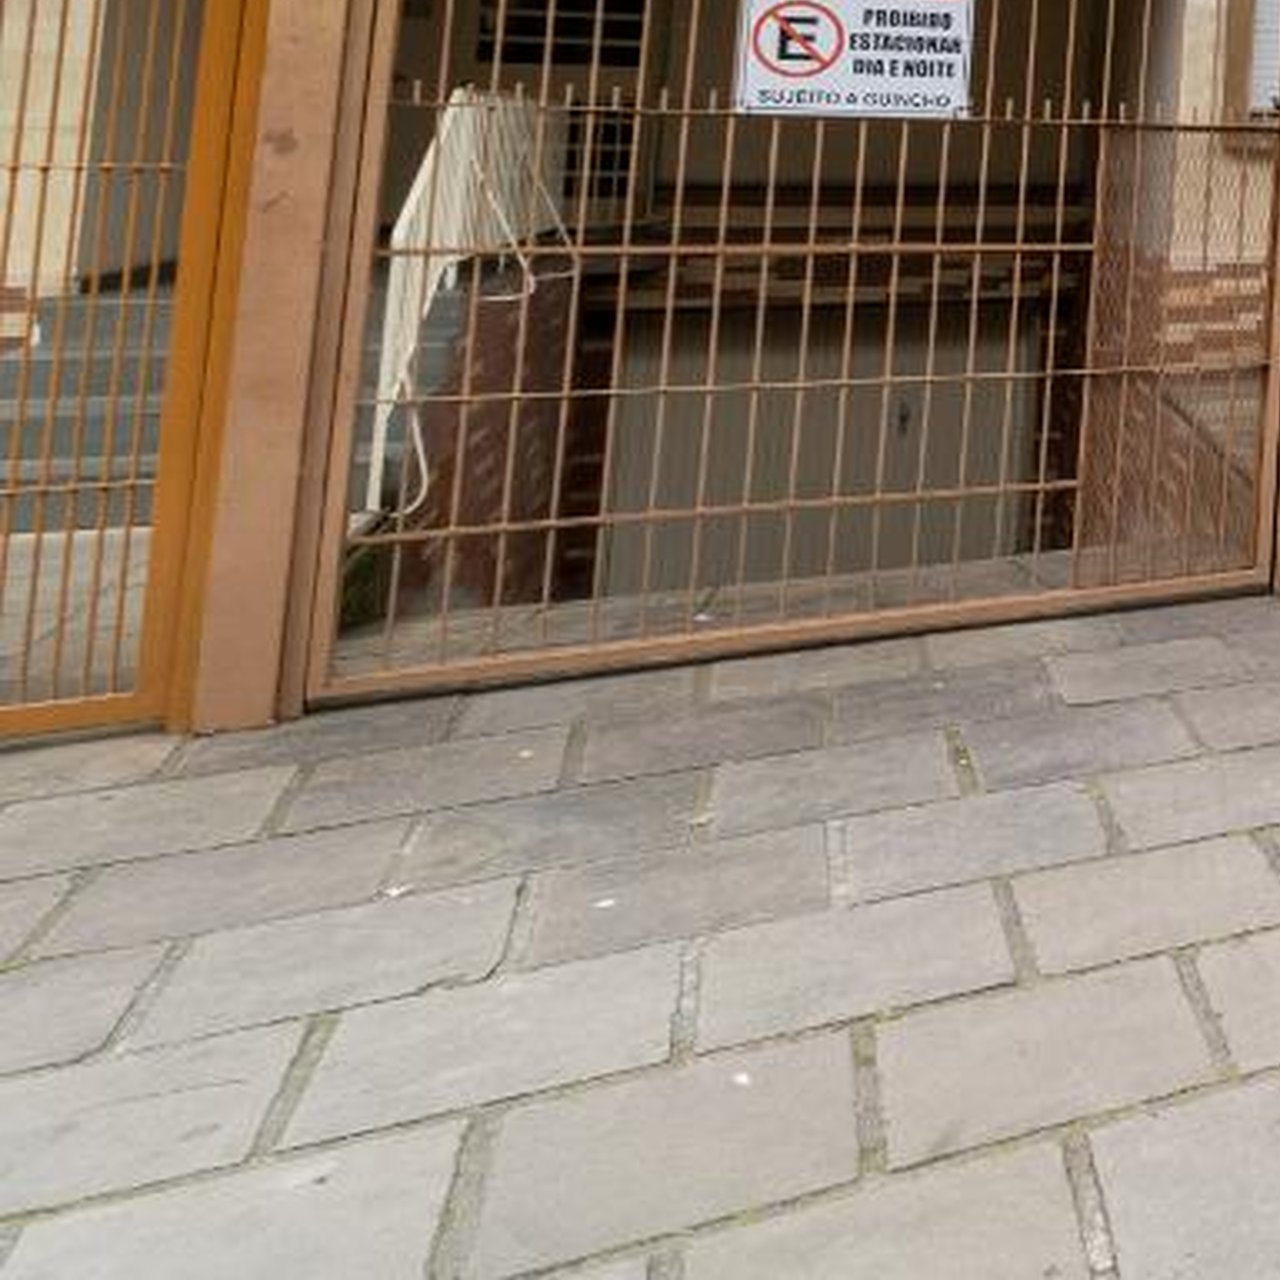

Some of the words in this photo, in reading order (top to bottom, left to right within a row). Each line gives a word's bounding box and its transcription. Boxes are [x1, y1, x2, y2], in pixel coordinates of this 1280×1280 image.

[862, 9, 952, 30] PROIBIDO
[850, 34, 963, 54] ESTACIONAR
[852, 59, 885, 75] DIA
[890, 60, 899, 77] E
[902, 60, 956, 78] NOITE
[757, 89, 841, 105] SUJEITO
[862, 91, 951, 108] GUINCHO
